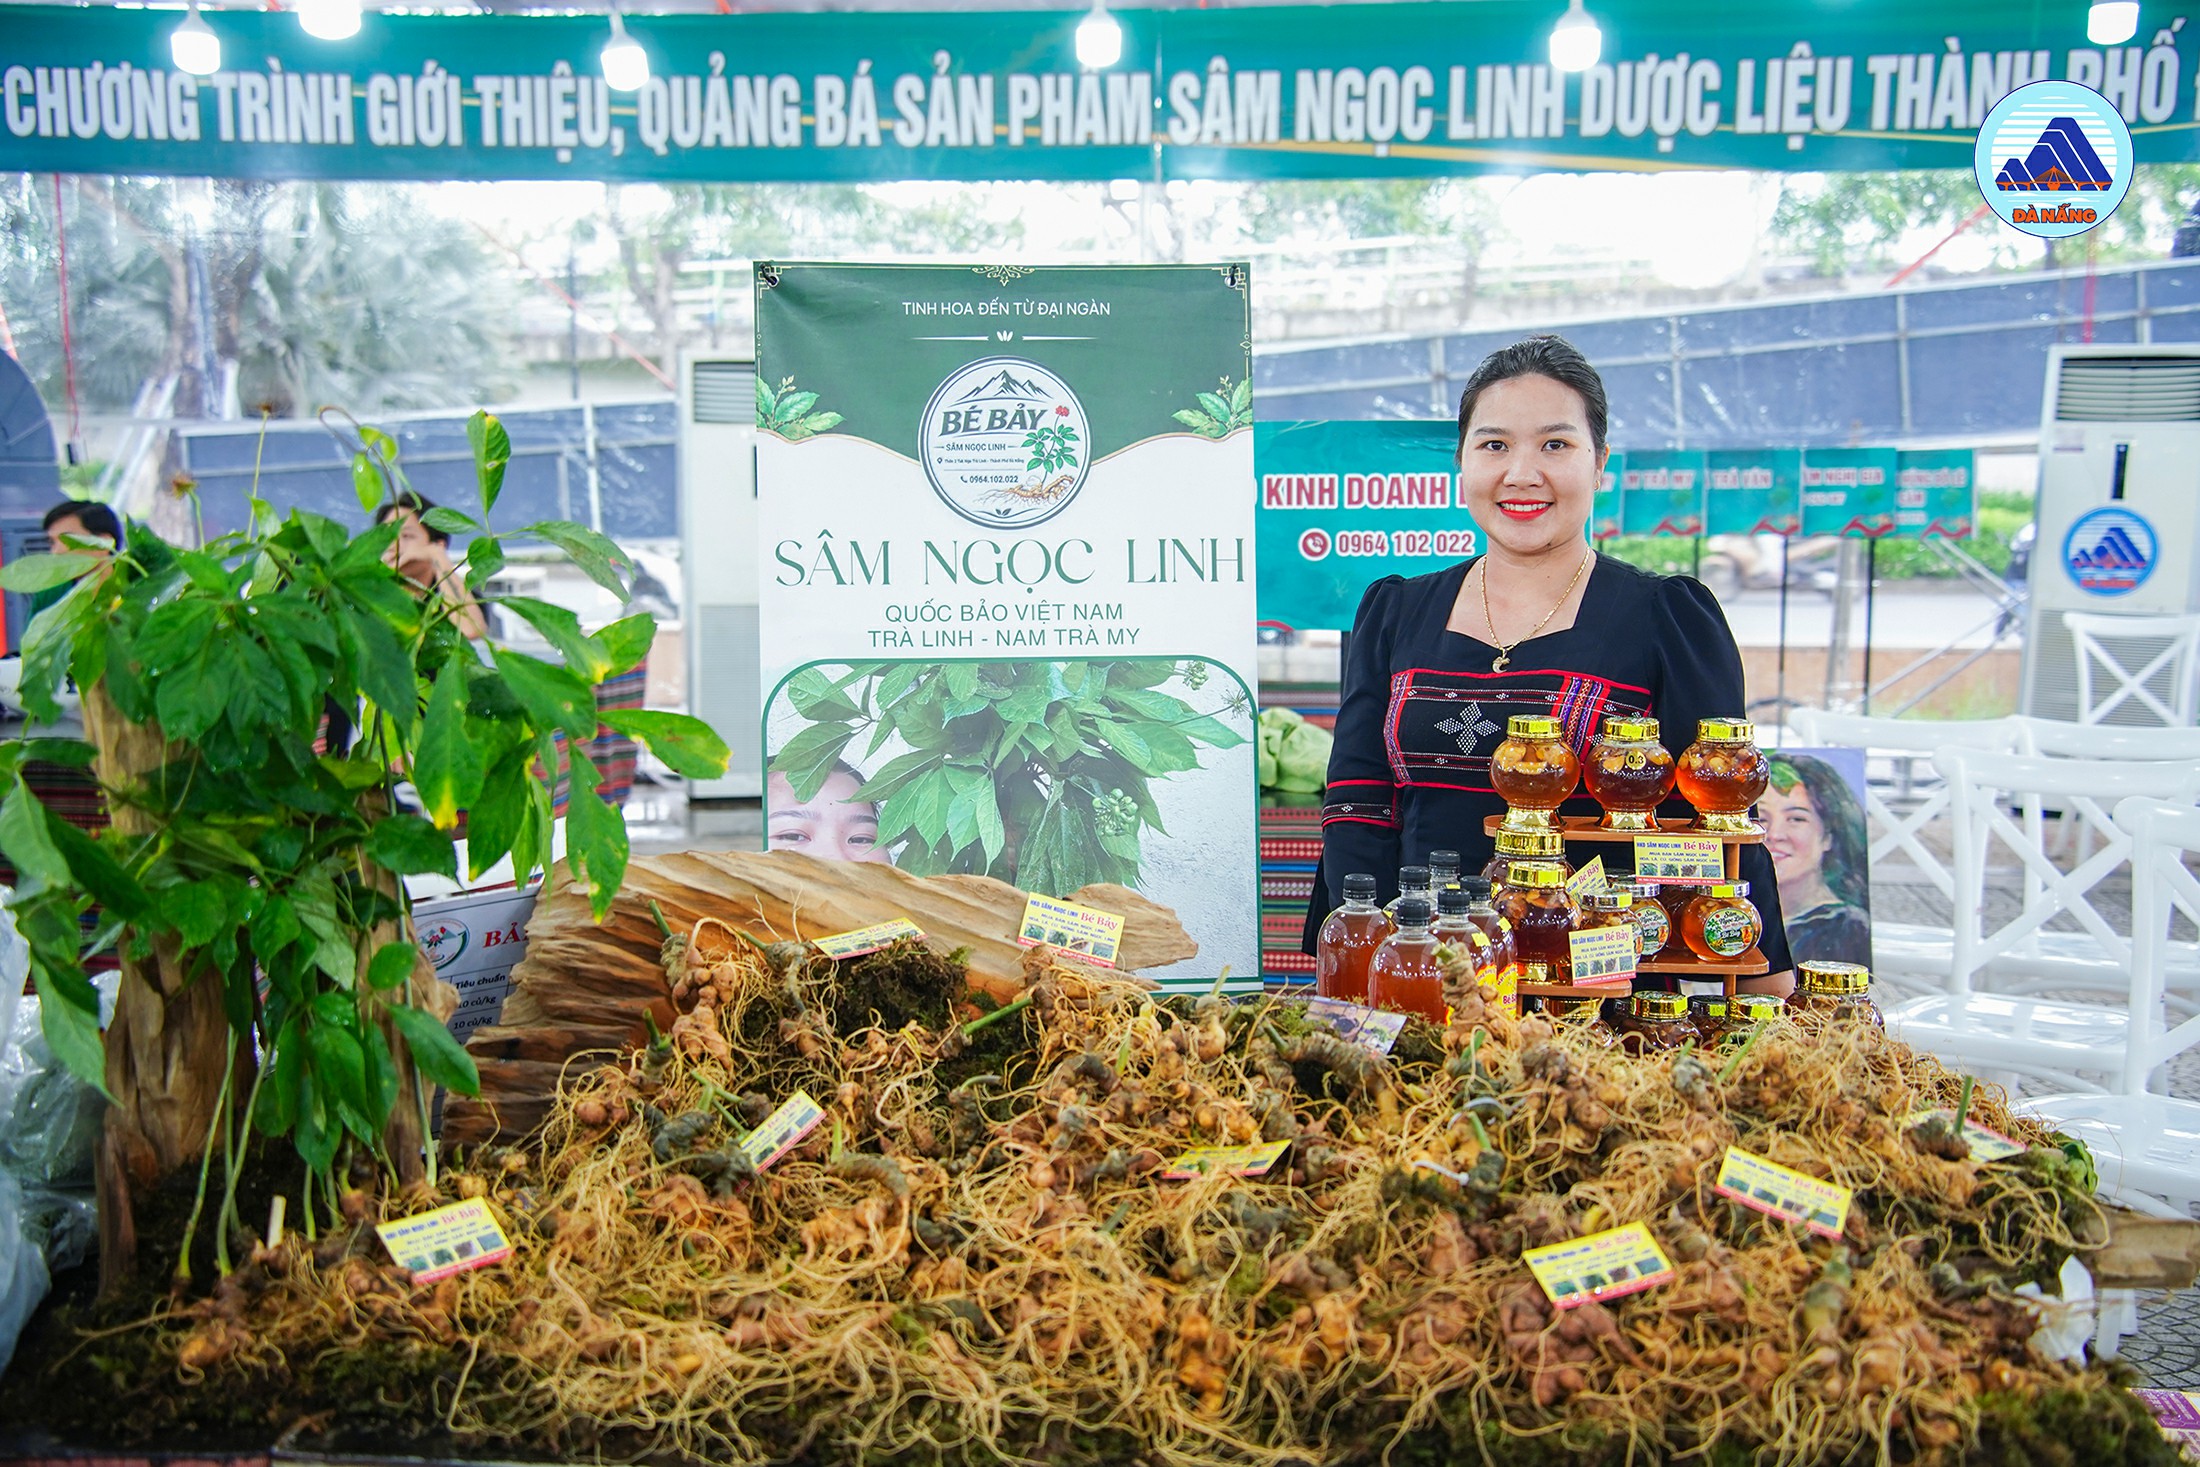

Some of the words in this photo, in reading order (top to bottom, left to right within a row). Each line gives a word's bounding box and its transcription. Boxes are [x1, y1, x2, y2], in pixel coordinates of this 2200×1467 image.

[3, 60, 201, 142] CHƯƠNG
[212, 56, 355, 145] TRÌNH
[366, 59, 464, 147] GIỚI
[473, 59, 625, 163] THIỆU,
[637, 51, 801, 156] QUẢNG
[813, 58, 880, 147] BÁ
[893, 48, 994, 147] SẢN
[1167, 56, 1281, 145] SÂM
[1295, 64, 1434, 157] NGỌC
[1447, 63, 1564, 140] LINH
[1580, 52, 1722, 153] DƯỢC
[1735, 41, 1852, 151] LIỆU
[902, 301, 937, 316] TINH
[941, 301, 974, 316] HOA
[977, 297, 1010, 316] ĐẾN
[1013, 298, 1035, 316] TỪ
[1037, 301, 1063, 319] ĐẠI
[1067, 298, 1110, 316] NGÀN
[938, 405, 983, 437] BÉ
[984, 403, 1047, 431] BẢY
[945, 443, 964, 452] SÂM
[964, 443, 987, 452] NGỌC
[988, 443, 1006, 451] LINH
[970, 475, 1018, 483] 0964.102.022
[1265, 476, 1336, 507] KINH
[1346, 475, 1448, 507] DOANH
[1338, 533, 1386, 553] 0964
[1394, 533, 1429, 553] 102
[1436, 532, 1474, 553] 022
[775, 528, 891, 587] SÂM
[924, 538, 1096, 595] NGỌC
[1127, 537, 1245, 585] LINH
[885, 598, 952, 623] QUỐC
[960, 598, 1008, 622] BẢO
[1014, 599, 1066, 625] VIỆT
[1073, 603, 1123, 621] NAM
[868, 626, 914, 648] TRÀ
[922, 630, 973, 648] LINH
[996, 629, 1046, 647] NAM
[1053, 624, 1099, 646] TRÀ
[1107, 628, 1141, 646] MY
[1628, 755, 1644, 765] 0.3
[1683, 840, 1697, 851] Bé
[1080, 912, 1095, 924] Bé
[1096, 916, 1118, 931] Bảy
[1605, 931, 1615, 942] Bé
[455, 978, 475, 990] Tiêu
[477, 973, 506, 986] chuẩn
[471, 996, 496, 1007] củ/kg
[454, 1021, 465, 1030] 10
[467, 1016, 492, 1027] củ/kg
